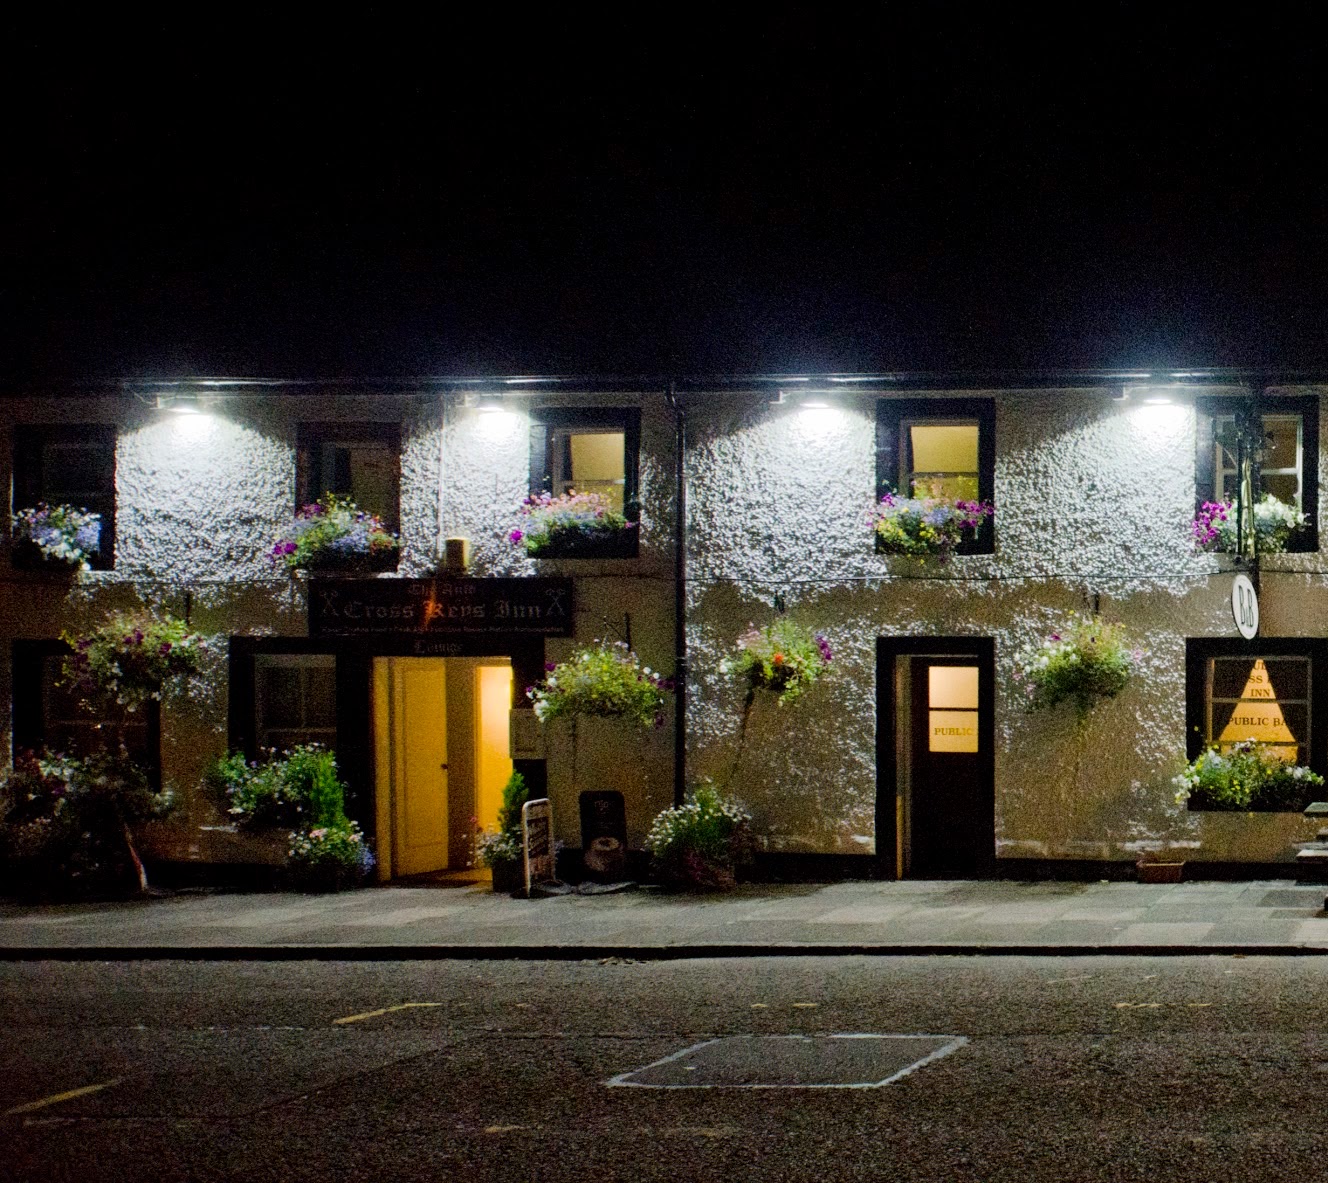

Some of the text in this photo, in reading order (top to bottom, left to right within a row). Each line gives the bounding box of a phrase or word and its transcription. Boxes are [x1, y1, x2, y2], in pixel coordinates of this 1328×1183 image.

[343, 599, 543, 620] Cross Keys Inn
[1250, 688, 1271, 698] INN
[1229, 716, 1269, 726] PUBLIC
[934, 727, 974, 736] PUBLIC
